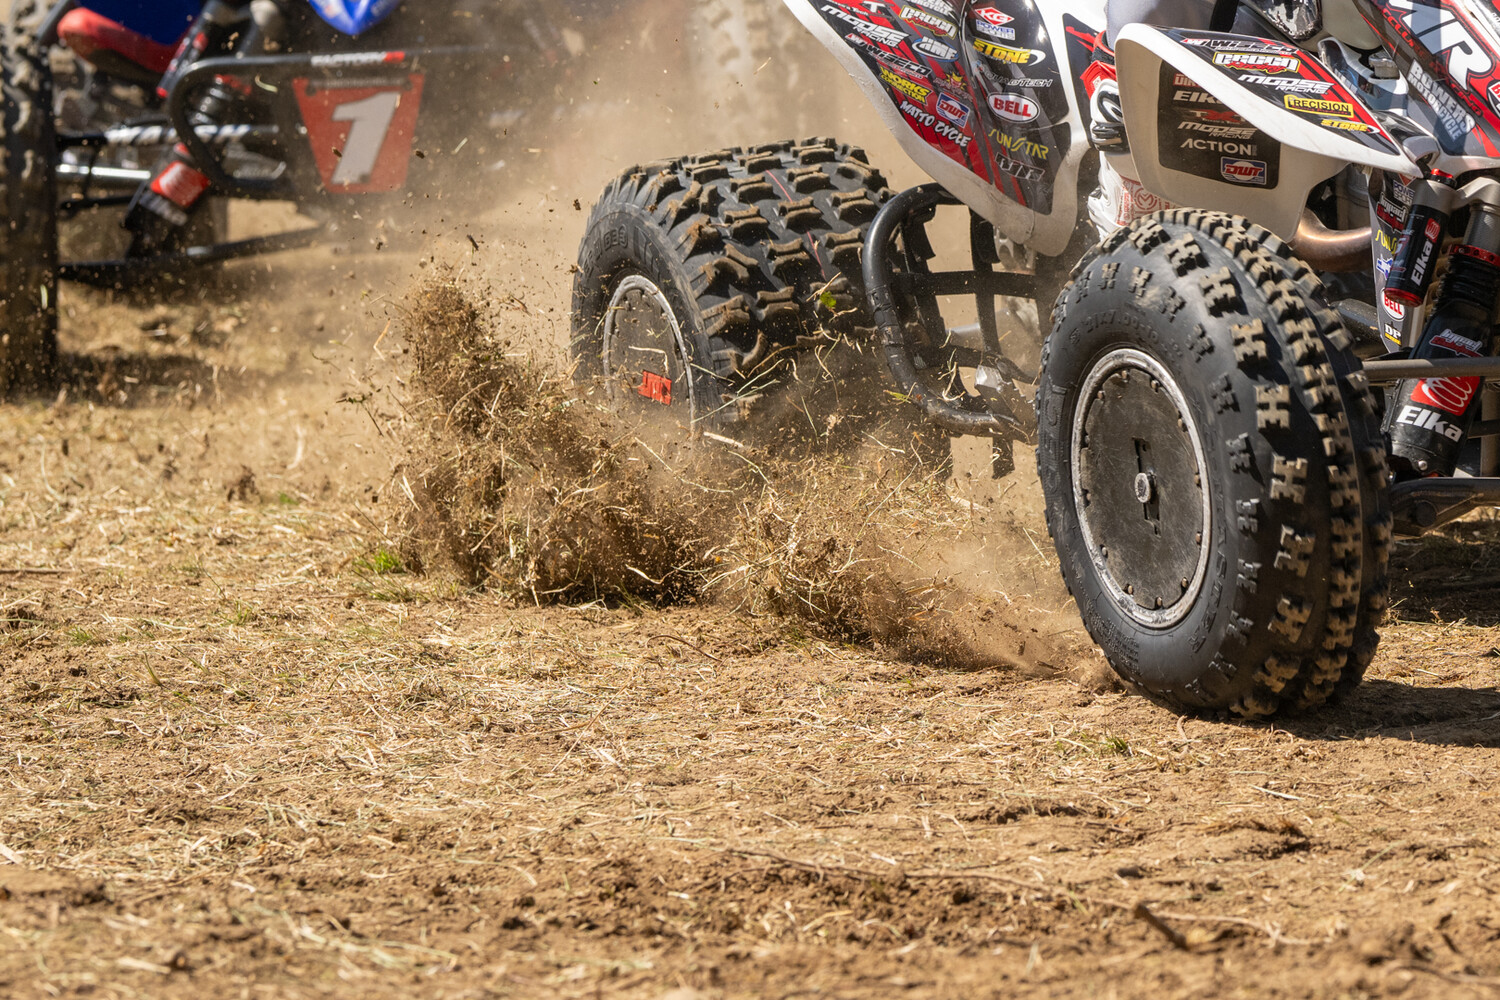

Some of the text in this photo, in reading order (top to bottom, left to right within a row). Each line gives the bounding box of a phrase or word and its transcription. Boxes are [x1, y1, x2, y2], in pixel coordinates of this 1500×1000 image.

[820, 4, 909, 41] MOOSE
[976, 20, 1015, 34] POWER
[979, 10, 1008, 23] KG
[852, 25, 899, 49] RACING
[866, 46, 932, 78] WISECO
[973, 39, 1032, 65] STONE
[880, 67, 934, 96] WORKS
[881, 74, 926, 104] CONNECTION
[1238, 74, 1336, 92] MOOSE
[1276, 84, 1328, 95] RACING
[993, 97, 1032, 118] BELL
[1173, 90, 1223, 104] Elk
[1287, 96, 1350, 113] PRECISION
[1408, 58, 1476, 136] BOWERS
[1408, 73, 1463, 142] MOTORCYCLE
[938, 100, 967, 119] DWT
[900, 100, 972, 147] MATTO CYCLE
[1178, 121, 1258, 137] MOOSE
[1321, 118, 1370, 133] STONE
[330, 90, 401, 185] 1
[1209, 130, 1255, 140] RACING
[1180, 138, 1253, 156] ACTION
[1225, 164, 1264, 178] DWT
[1410, 239, 1434, 287] Elka
[1384, 293, 1403, 317] BELL
[1385, 322, 1402, 339] DP
[1396, 404, 1464, 443] Elka
